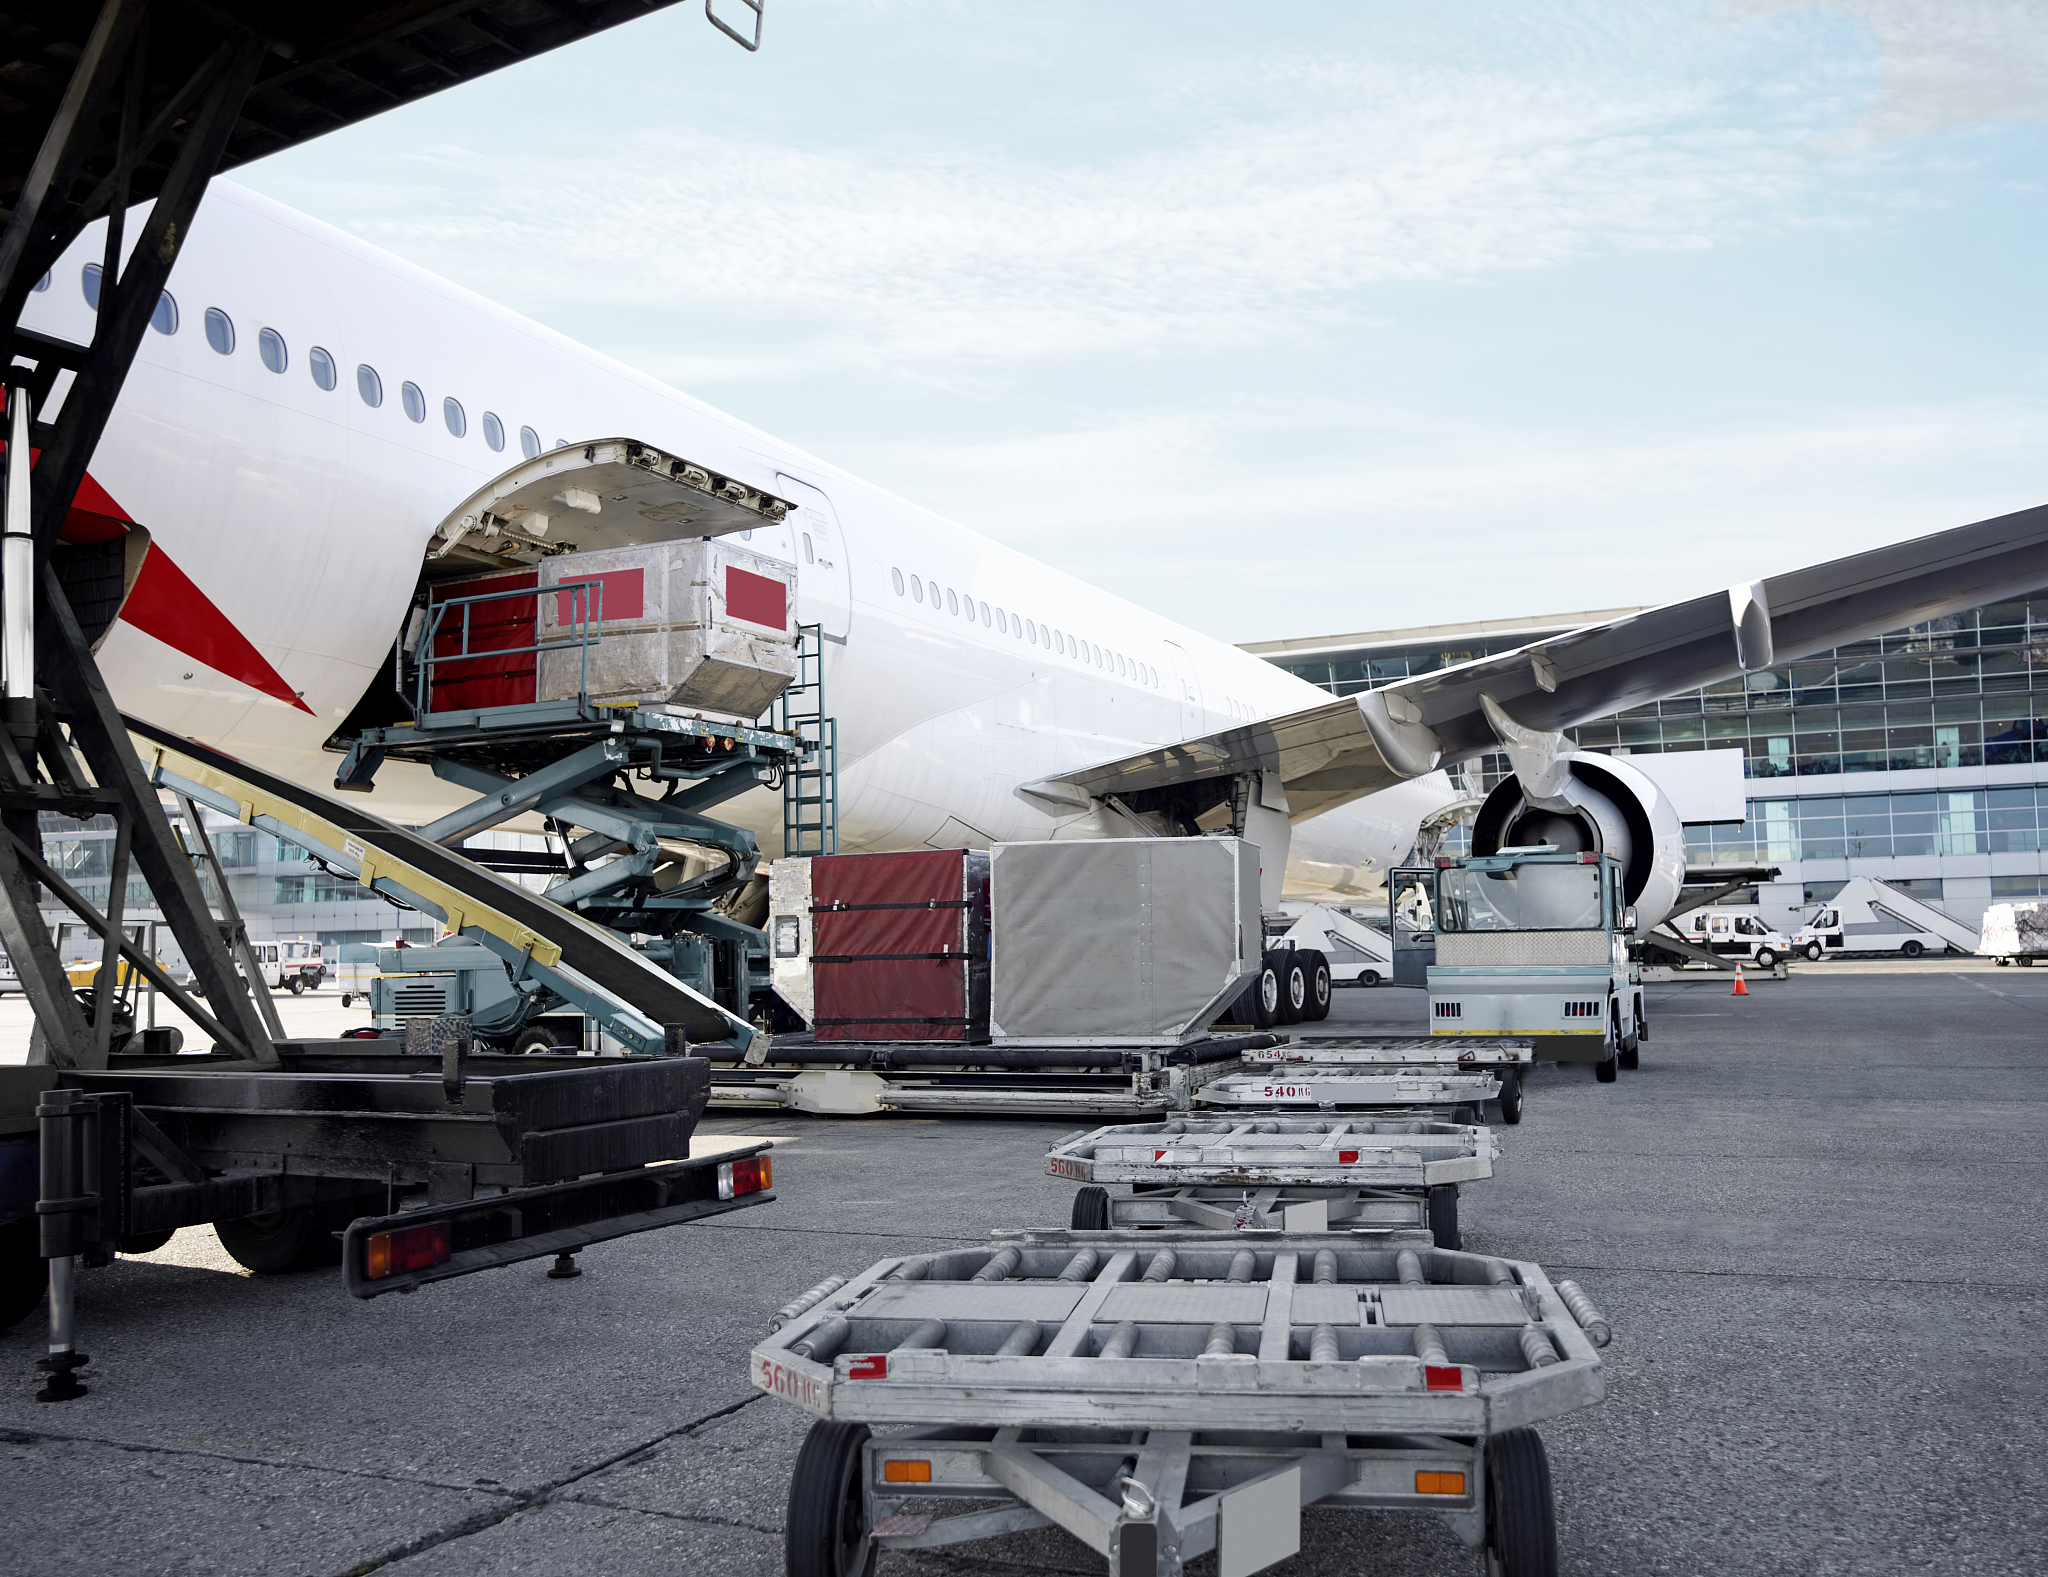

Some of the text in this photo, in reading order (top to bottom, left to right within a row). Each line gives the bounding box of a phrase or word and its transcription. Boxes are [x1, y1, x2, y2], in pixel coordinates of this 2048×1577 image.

[1258, 1050, 1292, 1059] 654 KG
[1264, 1086, 1311, 1097] 540 KG
[1051, 1158, 1073, 1176] 560
[762, 1360, 798, 1398] 560
